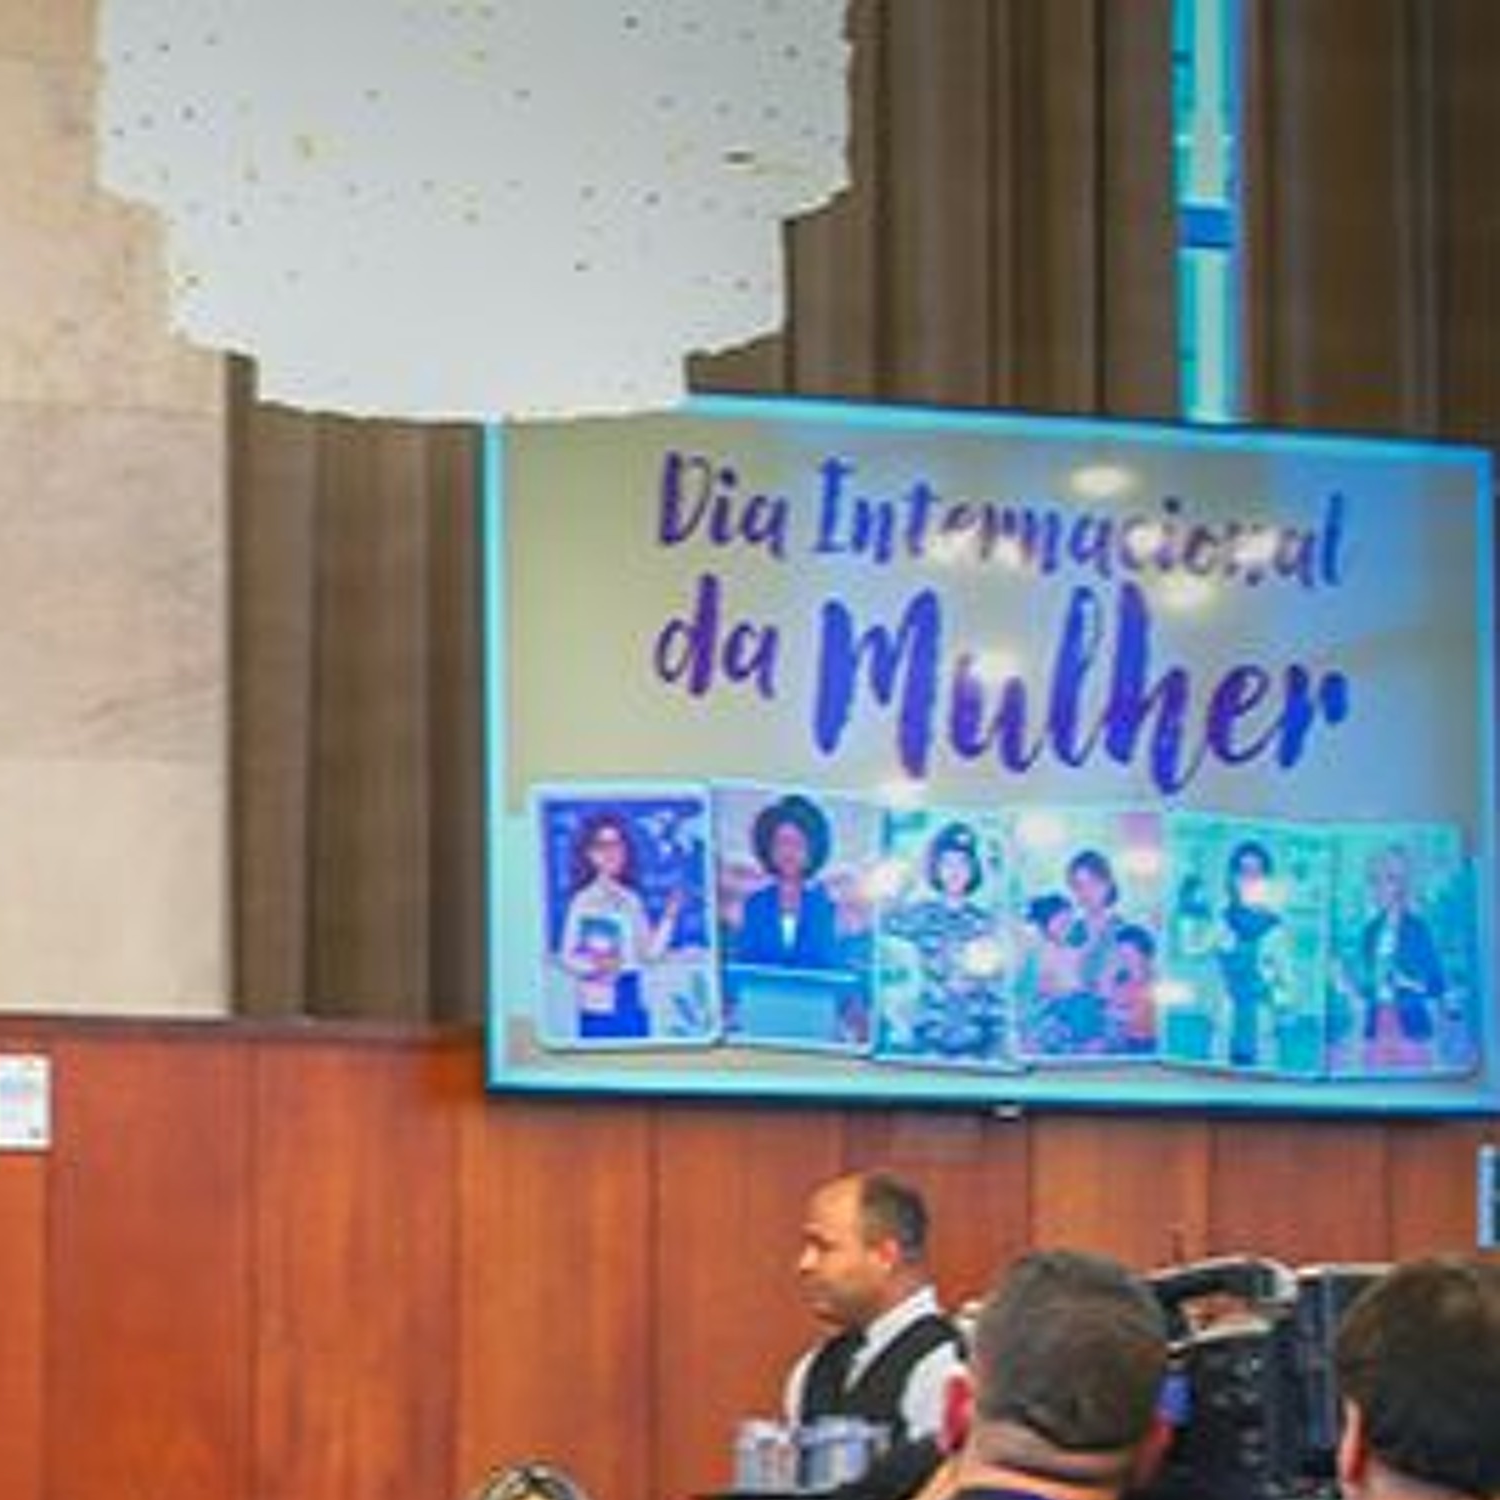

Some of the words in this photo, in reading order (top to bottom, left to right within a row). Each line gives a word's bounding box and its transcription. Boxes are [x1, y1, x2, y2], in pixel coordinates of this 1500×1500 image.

[660, 450, 786, 557] Dia
[655, 573, 779, 700] da
[812, 580, 1347, 796] Mulher
